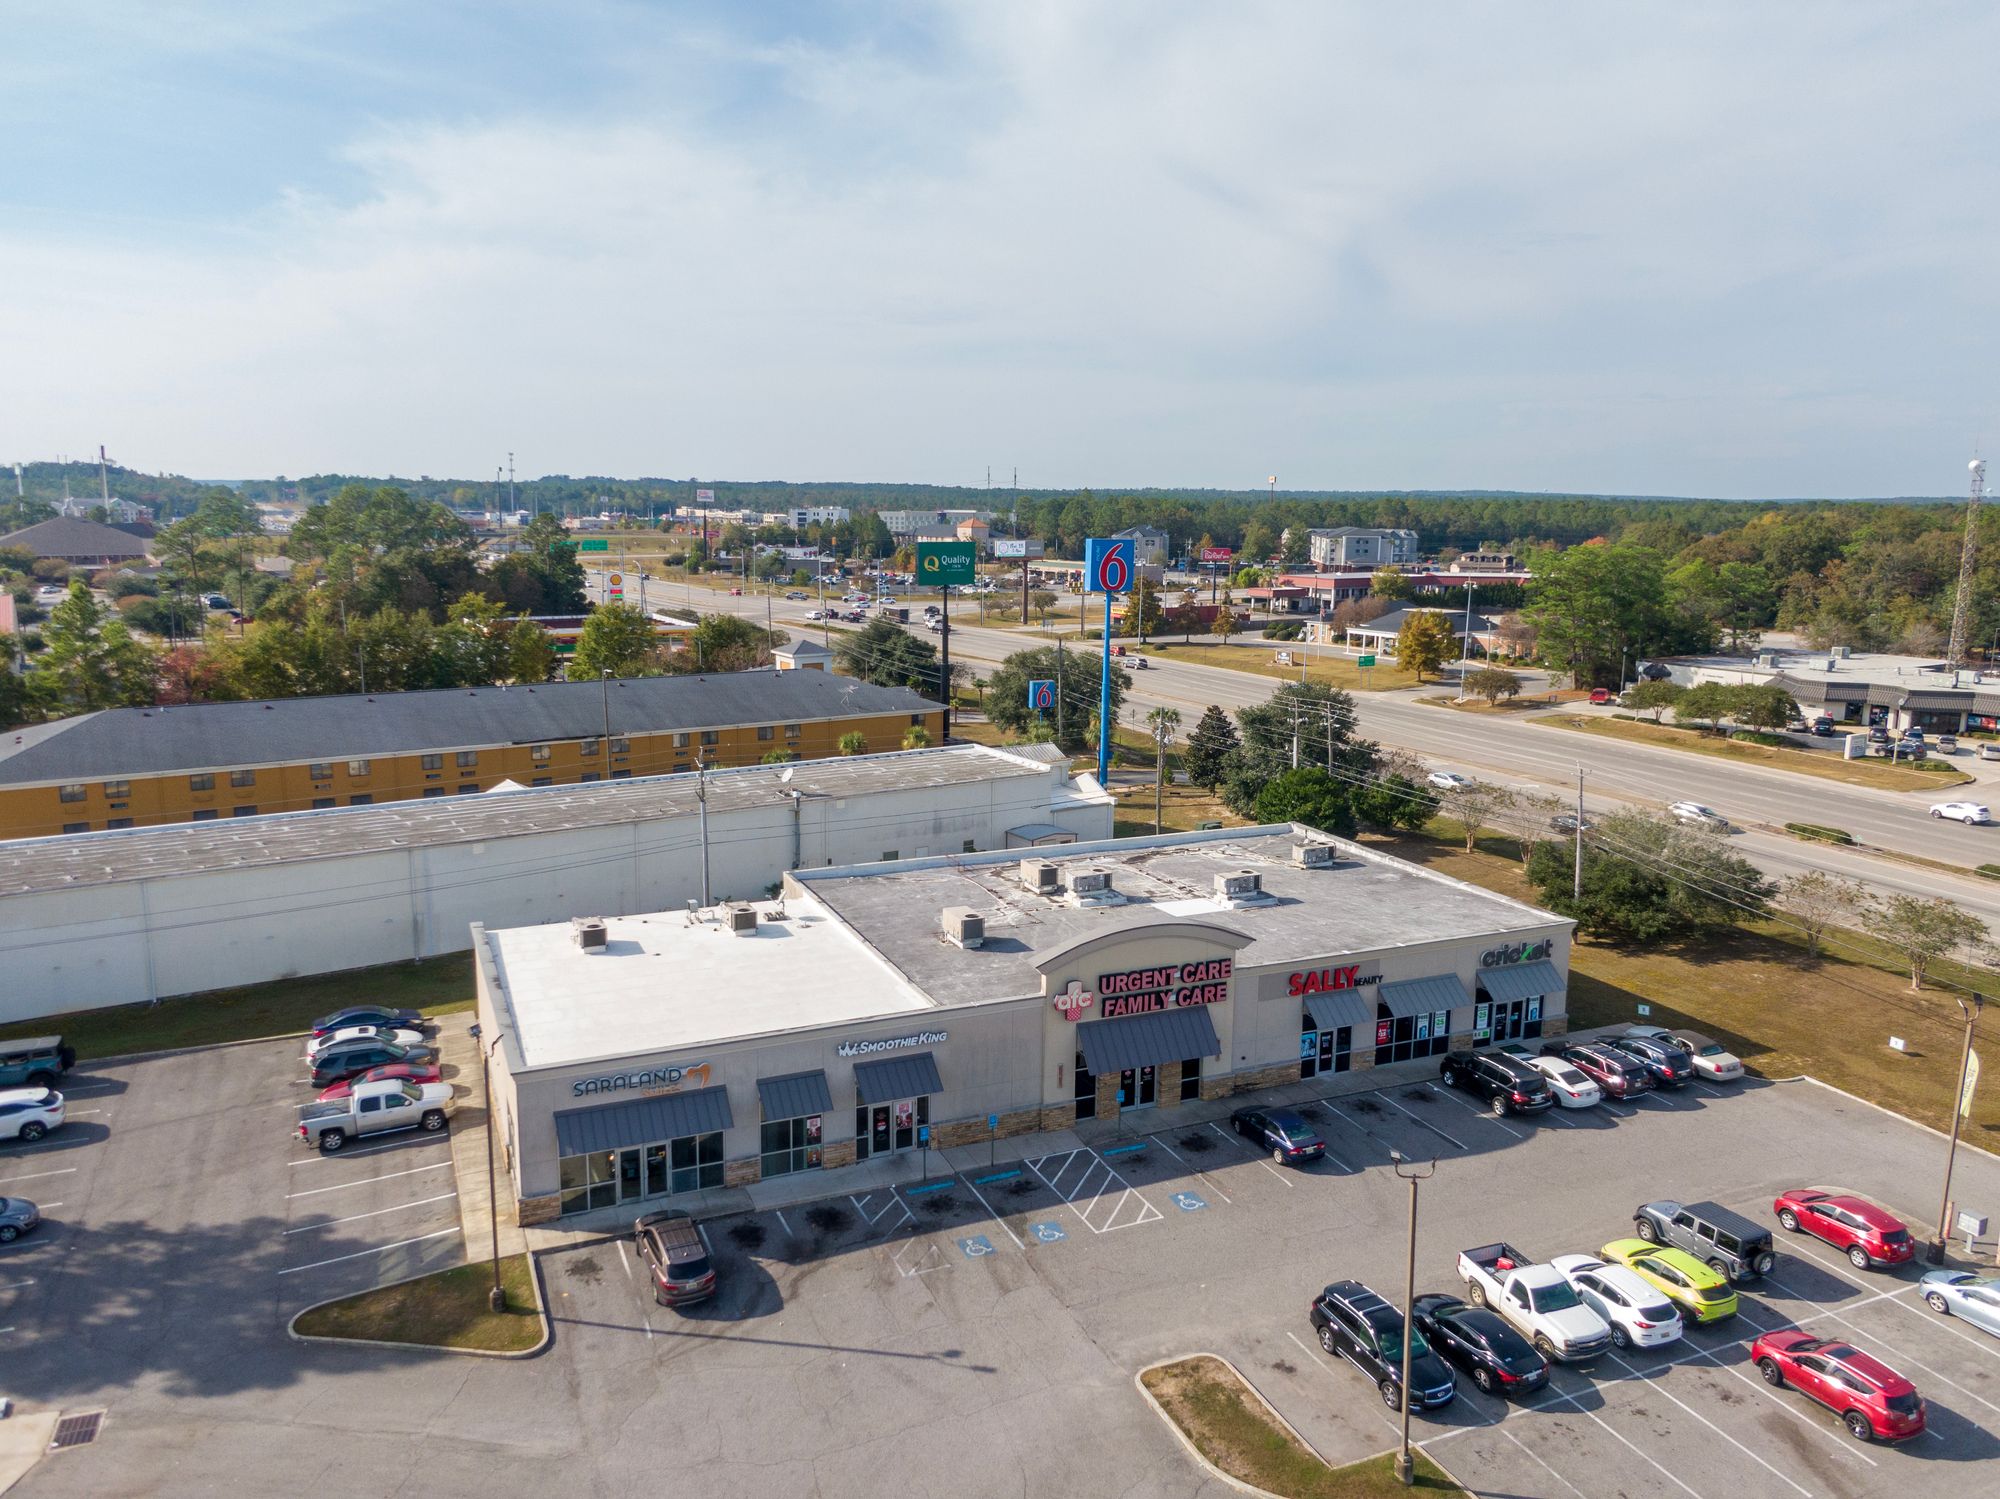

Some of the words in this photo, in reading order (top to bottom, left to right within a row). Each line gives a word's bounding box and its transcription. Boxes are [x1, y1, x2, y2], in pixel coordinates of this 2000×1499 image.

[924, 555, 940, 572] Q
[941, 555, 970, 565] Quality
[1099, 543, 1127, 591] 6
[1037, 681, 1052, 708] 6
[1481, 938, 1553, 967] cricket
[1100, 966, 1178, 995] URGENT
[1181, 959, 1232, 983] CARE
[1288, 964, 1360, 996] SALLY
[1354, 974, 1384, 987] BEAUTY
[1057, 988, 1092, 1010] afc
[1103, 990, 1173, 1018] FAMILY
[1177, 983, 1228, 1007] CARE
[573, 1067, 682, 1097] SARALAND
